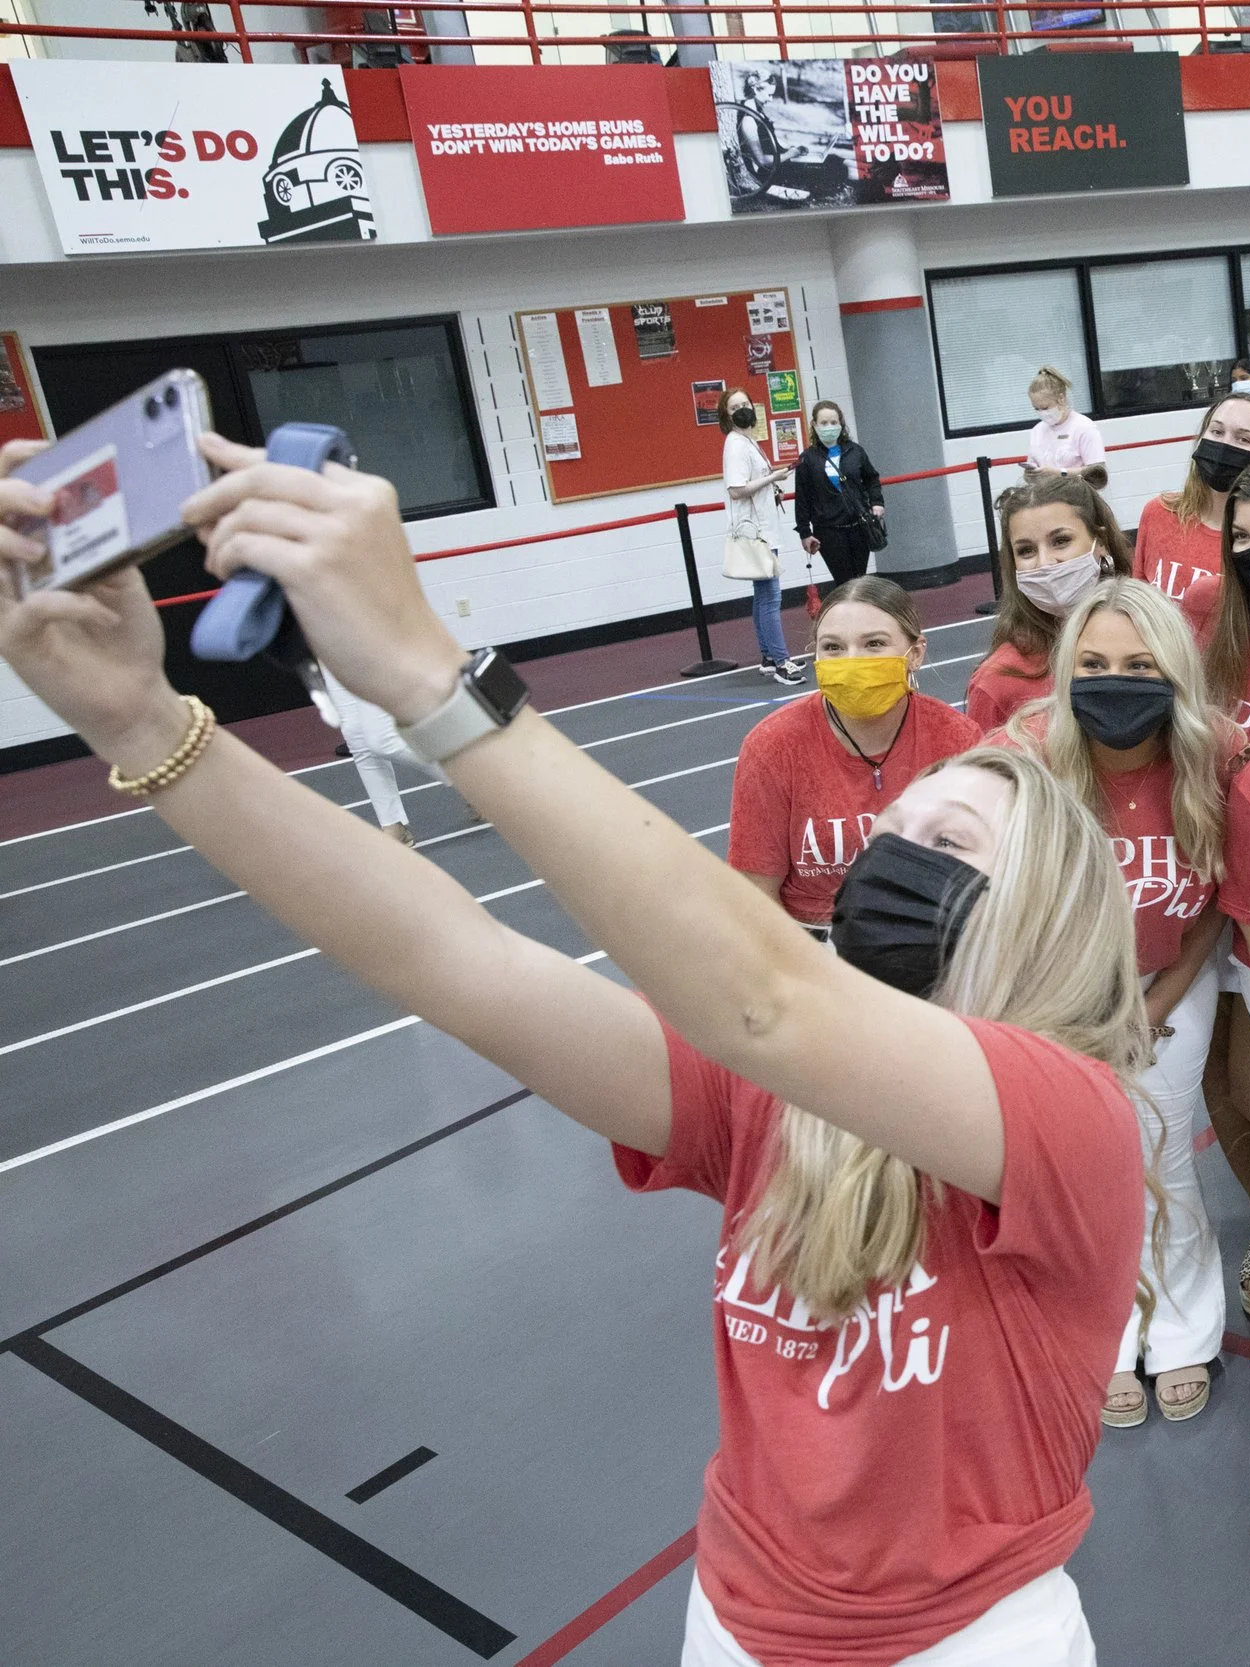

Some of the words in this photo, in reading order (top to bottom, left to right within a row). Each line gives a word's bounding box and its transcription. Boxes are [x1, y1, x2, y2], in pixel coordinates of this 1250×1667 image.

[850, 64, 882, 83] DO
[885, 63, 929, 82] YOU
[853, 84, 911, 103] HAVE
[856, 104, 899, 123] THE
[1003, 95, 1073, 122] YOU
[427, 121, 546, 139] YESTERDAY'S
[547, 120, 597, 135] HOME
[599, 119, 644, 134] RUNS
[858, 123, 909, 143] WILL
[1008, 123, 1127, 153] REACH.
[50, 130, 187, 164] LET'S
[192, 129, 259, 162] DO
[431, 139, 485, 155] DON'T
[489, 138, 524, 153] WIN
[528, 135, 598, 152] TODAY'S
[600, 134, 662, 149] GAMES.
[860, 144, 890, 162] TO
[893, 141, 935, 161] DO?
[604, 154, 634, 165] Babe
[636, 152, 663, 164] Ruth
[61, 166, 190, 201] THIS.
[79, 236, 151, 246] WillToDo.semo.edu
[796, 812, 877, 867] ALP
[797, 866, 848, 878] ESTABLISH
[775, 1336, 819, 1360] 1872
